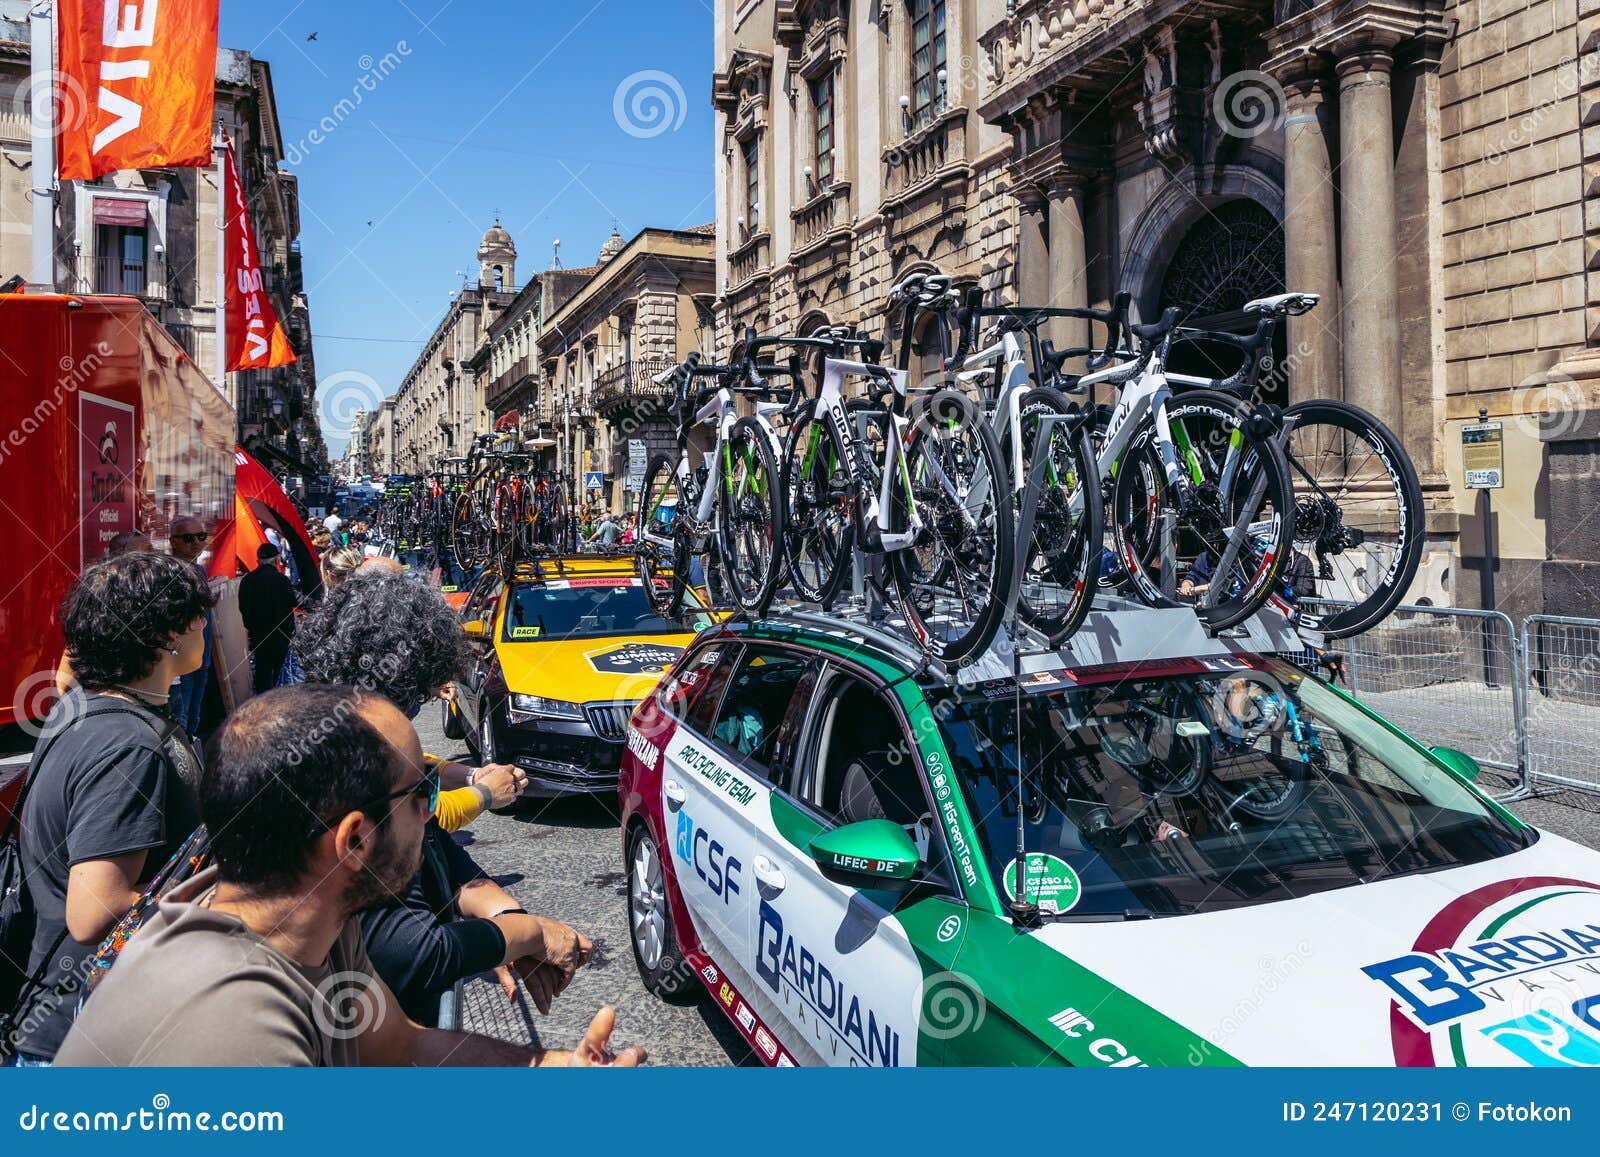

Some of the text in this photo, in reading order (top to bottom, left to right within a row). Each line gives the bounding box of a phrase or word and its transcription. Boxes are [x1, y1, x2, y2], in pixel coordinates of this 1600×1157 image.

[516, 628, 537, 636] RACE
[678, 745, 757, 806] PRO CYCLING TEAM
[694, 827, 742, 905] CSF
[943, 801, 977, 887] #GreenTeam
